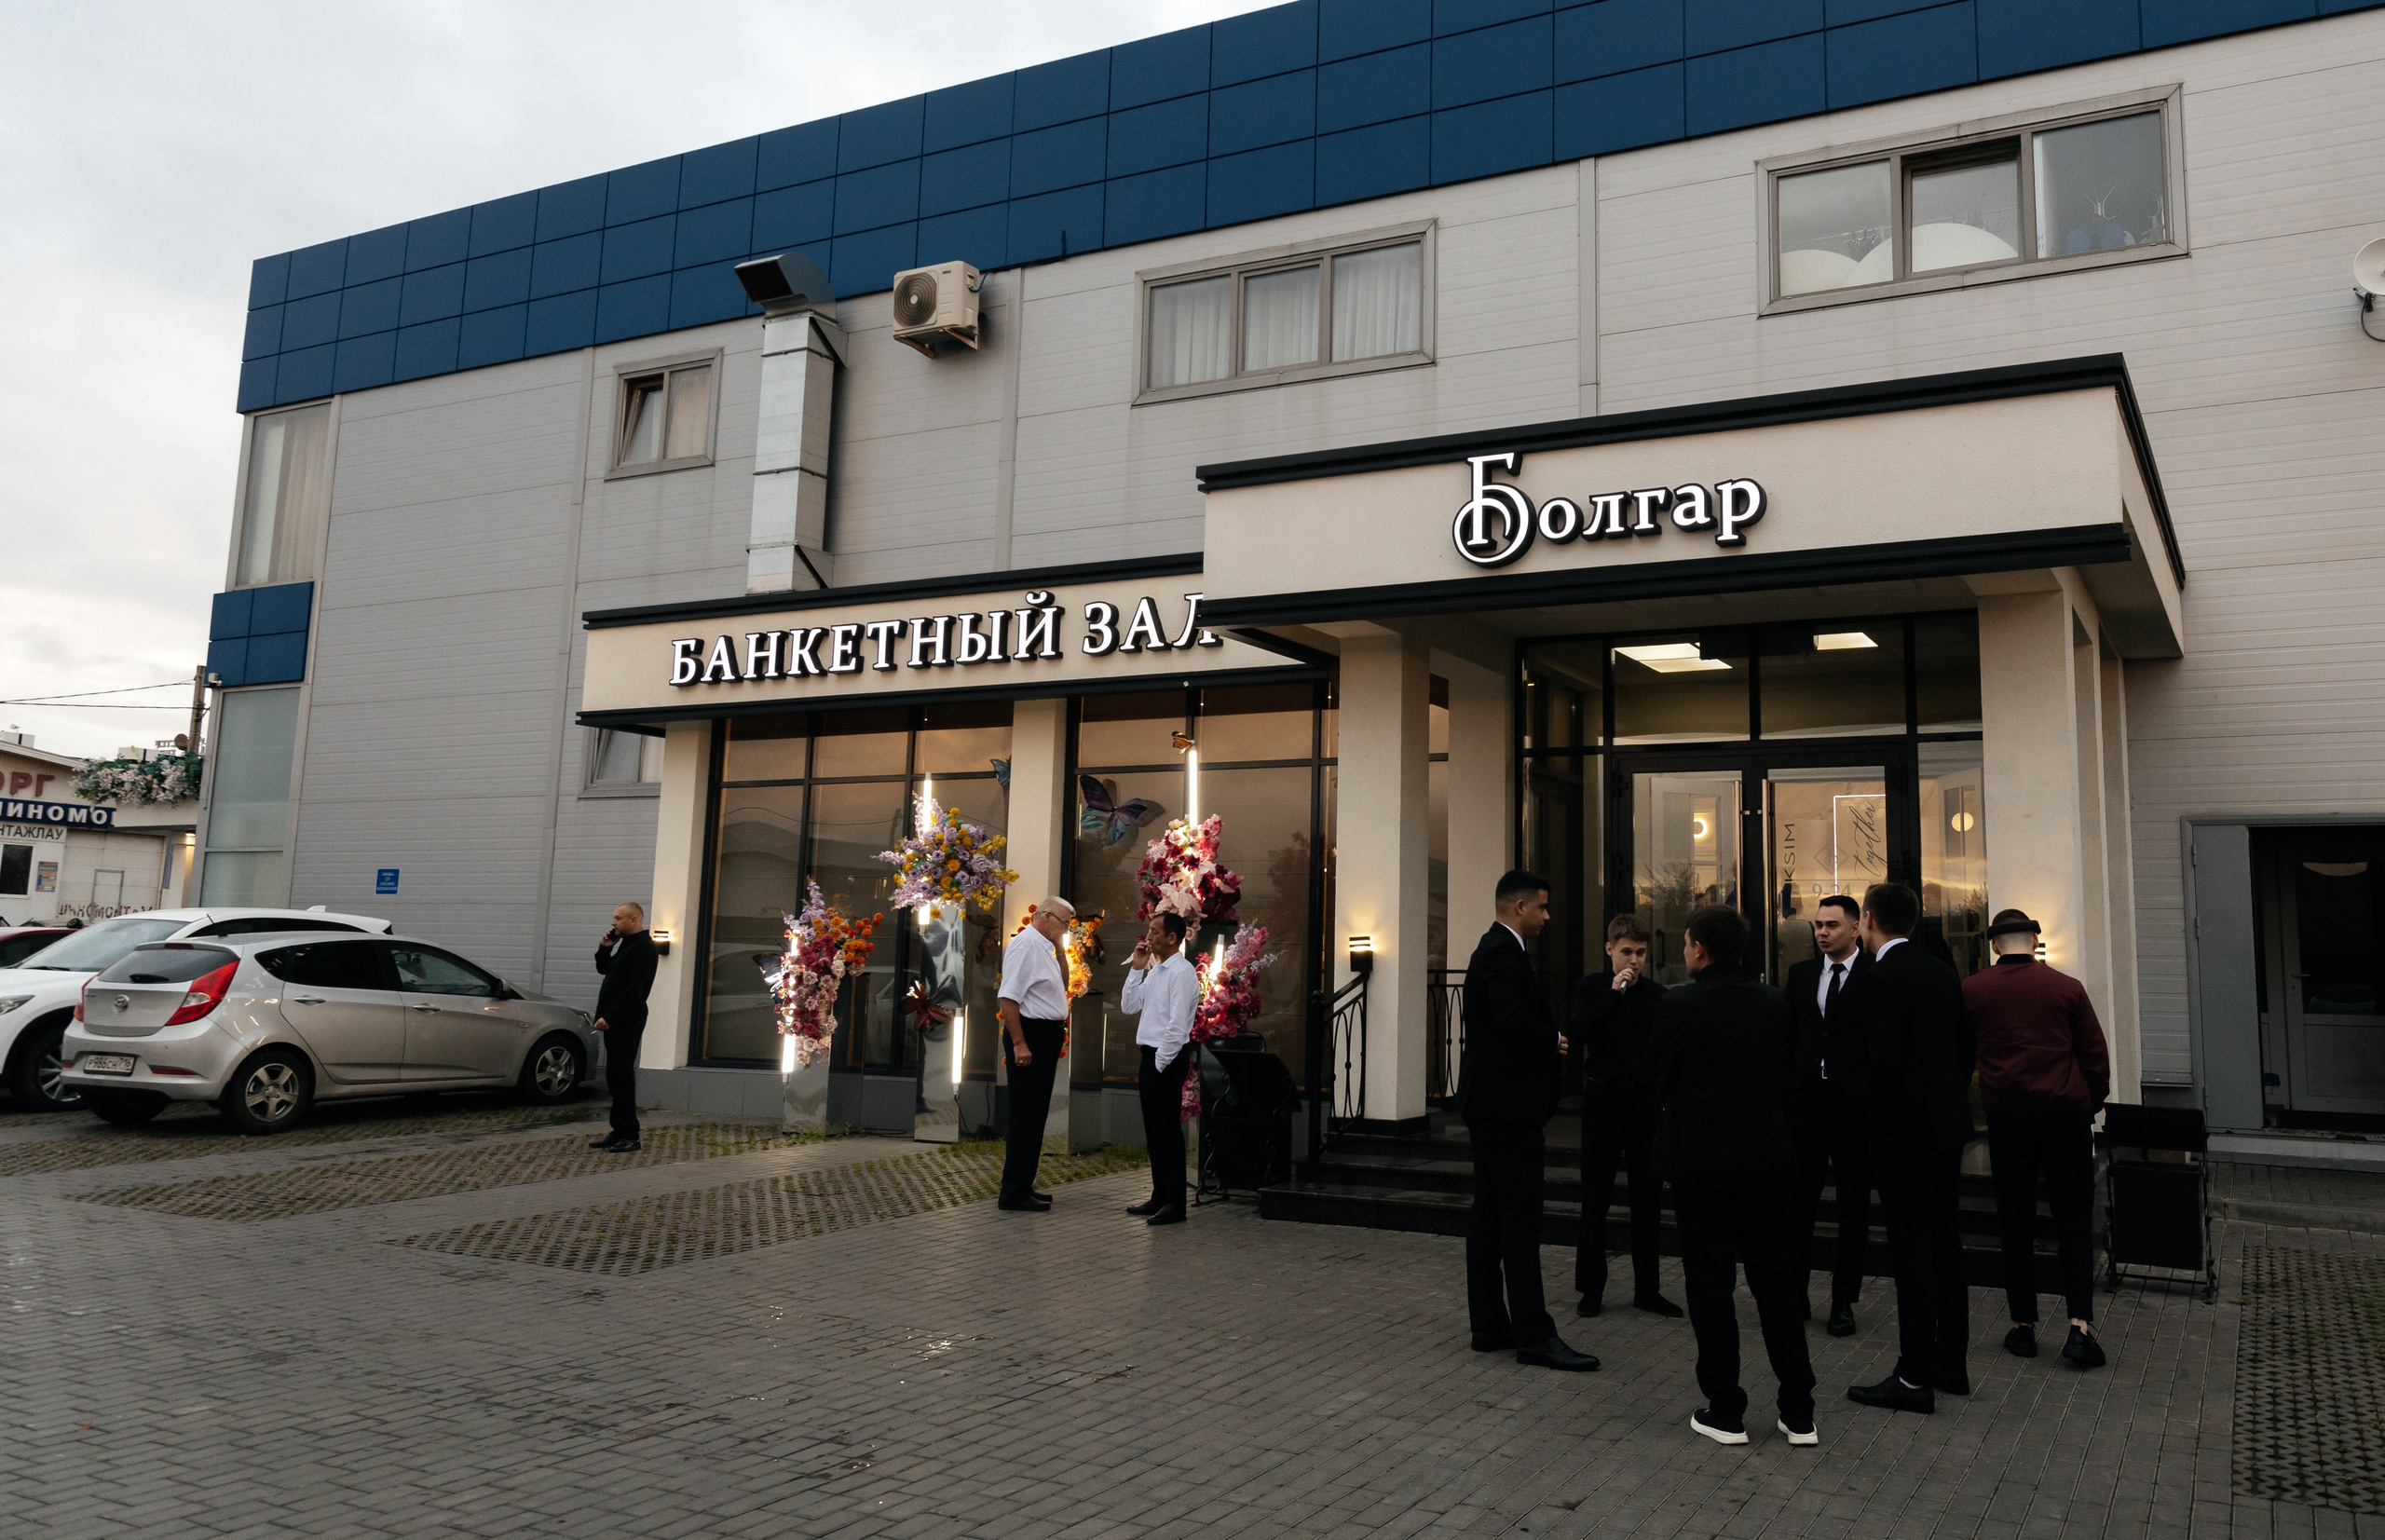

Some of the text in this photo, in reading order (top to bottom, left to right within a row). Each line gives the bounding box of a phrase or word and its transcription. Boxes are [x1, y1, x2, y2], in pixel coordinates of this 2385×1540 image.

[1452, 452, 1767, 568] Болгар
[669, 591, 1223, 687] БАНКЕТНЫЙ ЗАЛ
[0, 770, 55, 797] РГ
[0, 801, 116, 825] ИНОМО
[1783, 824, 1796, 882] KSIM
